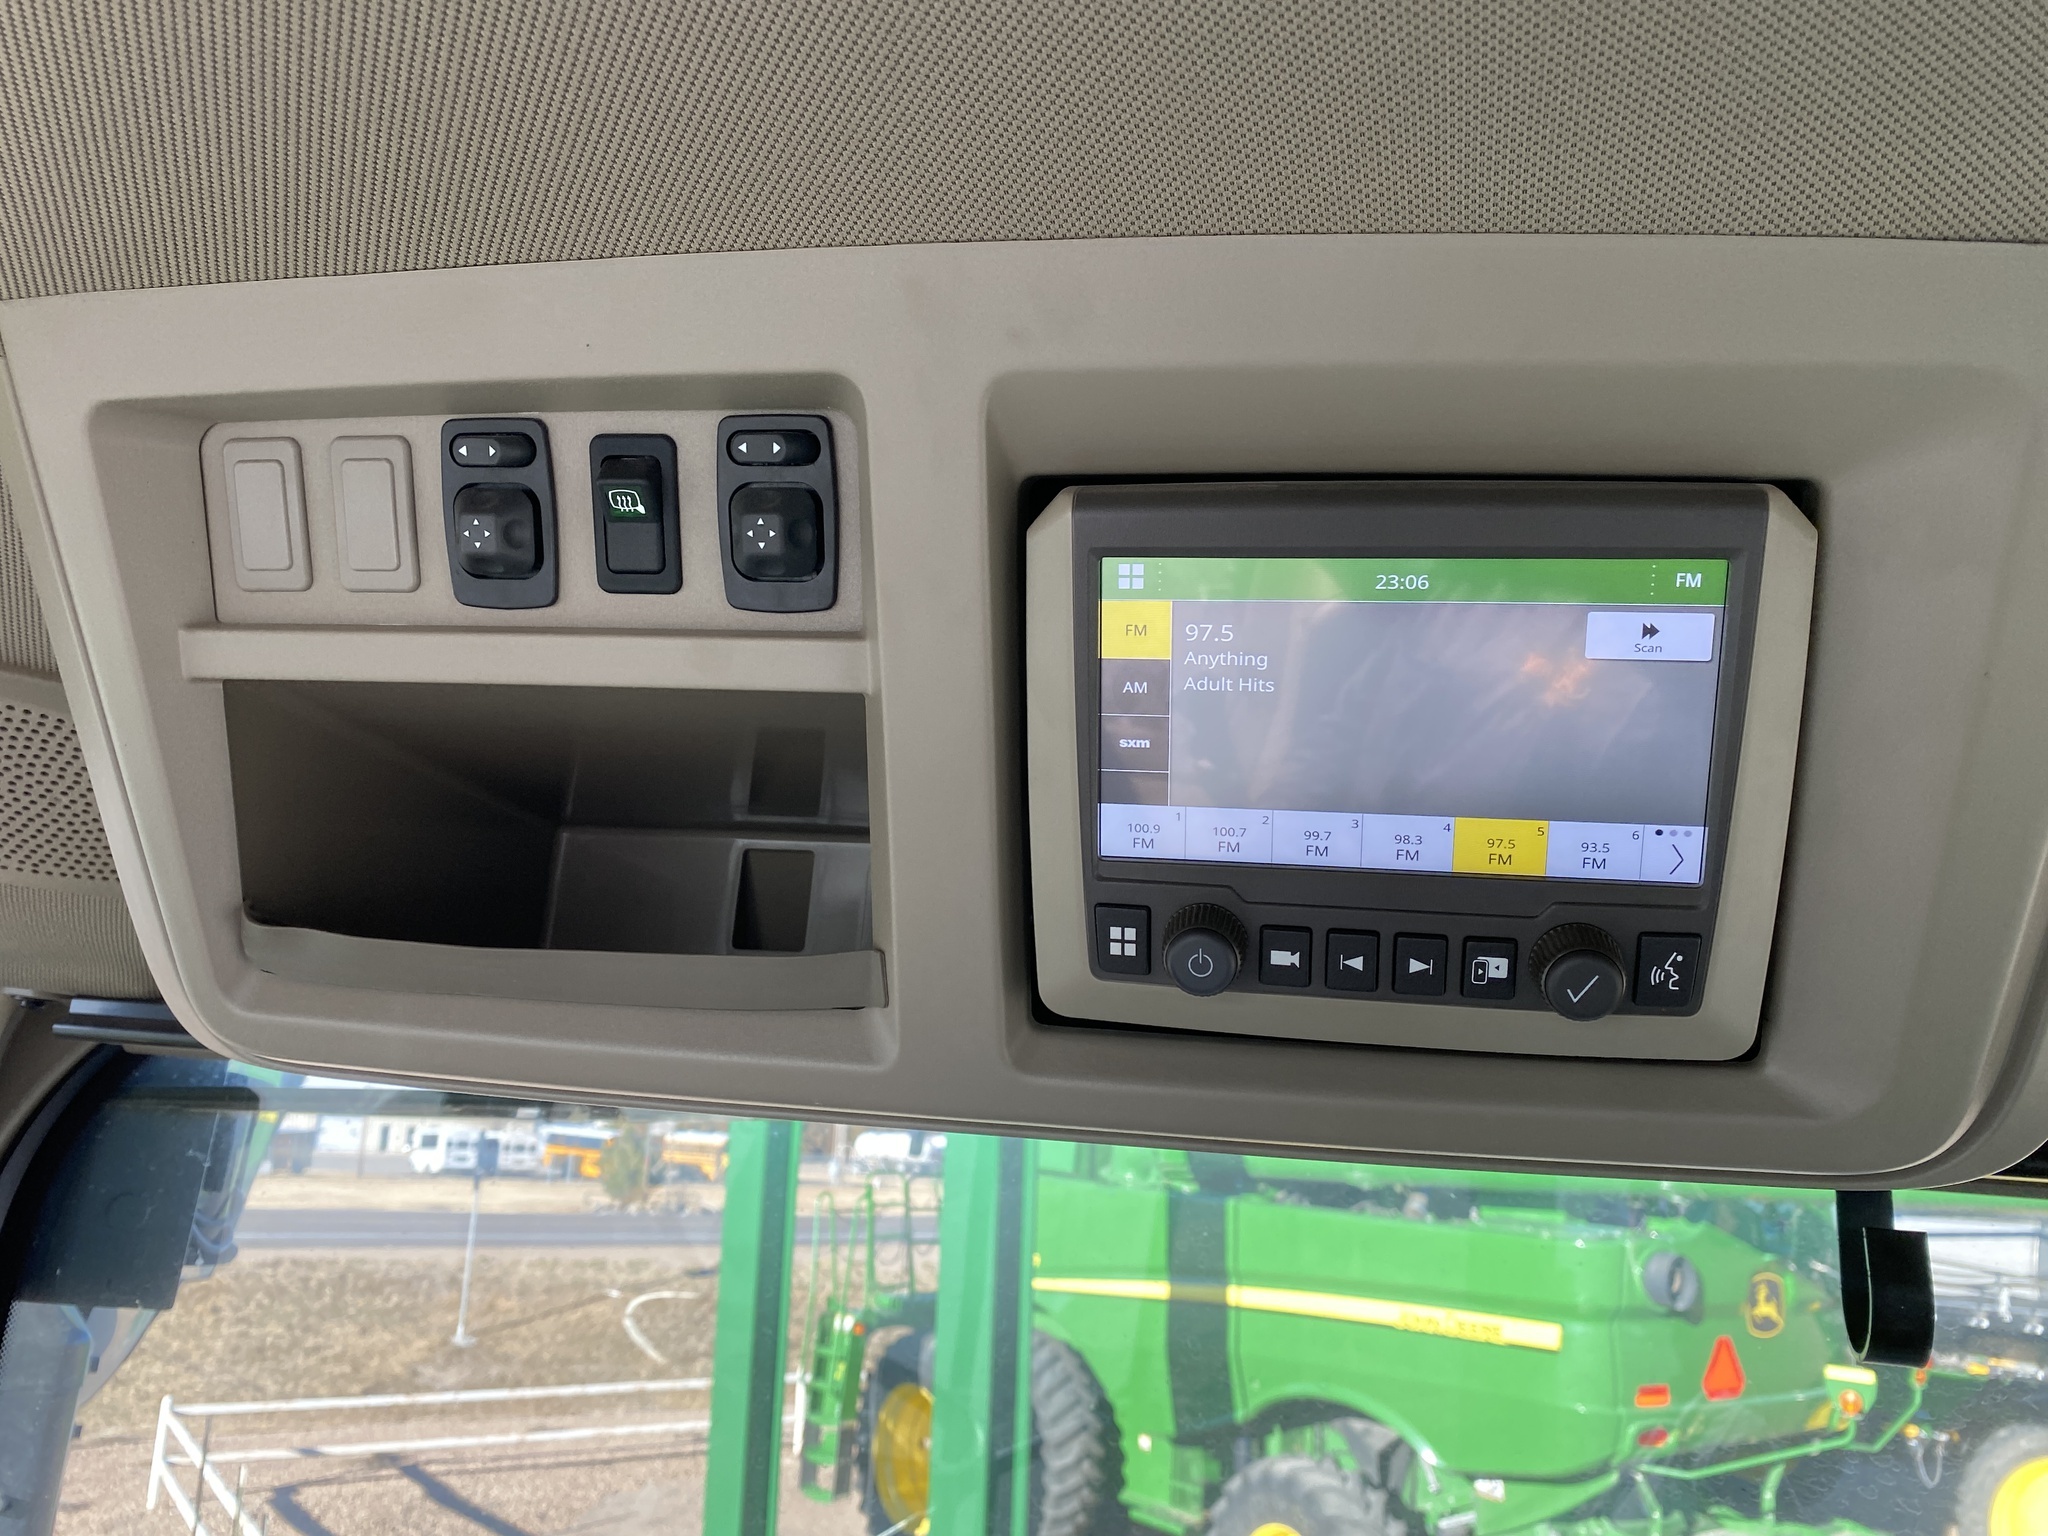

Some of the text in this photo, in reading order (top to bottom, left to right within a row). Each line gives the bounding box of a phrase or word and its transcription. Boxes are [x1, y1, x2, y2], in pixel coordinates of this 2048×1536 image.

[1375, 574, 1430, 591] 23:06
[1675, 572, 1702, 588] FM
[1125, 624, 1147, 637] FM
[1185, 623, 1234, 642] 97.5
[1634, 643, 1663, 653] Scan
[1183, 651, 1268, 671] Anything
[1122, 681, 1148, 694] AM
[1183, 676, 1275, 693] Adult Hits
[1119, 738, 1151, 748] sxm
[1176, 812, 1181, 821] 1
[1262, 815, 1270, 825] 2
[1127, 823, 1161, 834] 100.9
[1351, 819, 1359, 829] 3
[1443, 823, 1451, 833] 4
[1213, 826, 1247, 838] 100.7
[1303, 830, 1332, 841] 99.7
[1537, 826, 1545, 837] 5
[1632, 830, 1640, 841] 6
[1133, 837, 1154, 849] FM
[1394, 834, 1423, 845] 98.3
[1486, 838, 1516, 850] 97.5
[1218, 841, 1240, 853] FM
[1306, 844, 1329, 857] FM
[1581, 842, 1610, 853] 93.5
[1396, 849, 1419, 862] FM
[1488, 853, 1512, 866] FM
[1582, 857, 1606, 870] FM
